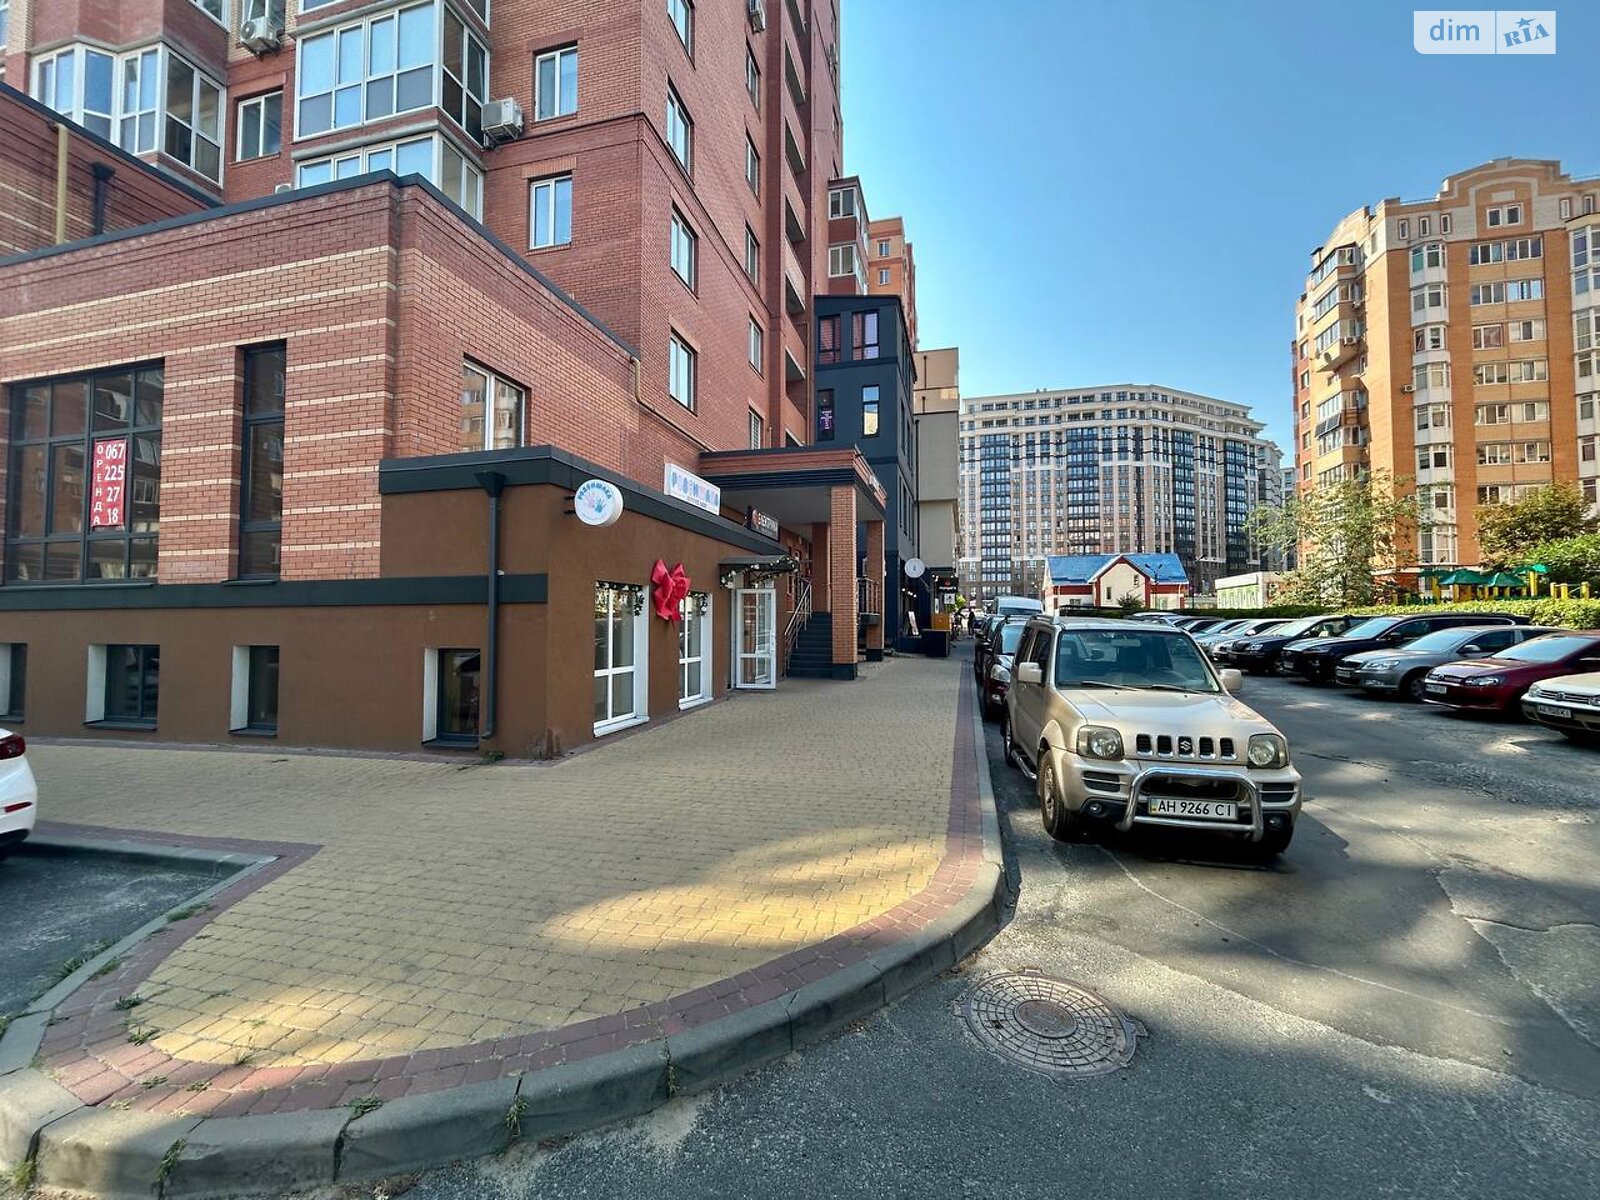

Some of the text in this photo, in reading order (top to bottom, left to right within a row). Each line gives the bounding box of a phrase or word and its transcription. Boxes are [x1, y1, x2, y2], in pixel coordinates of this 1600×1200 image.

[105, 443, 125, 460] 067
[104, 464, 125, 481] 225
[93, 444, 104, 525] ОРЕНДА
[106, 486, 121, 502] 27
[107, 507, 119, 525] 18
[1158, 800, 1176, 813] AH
[1180, 801, 1210, 815] 9266
